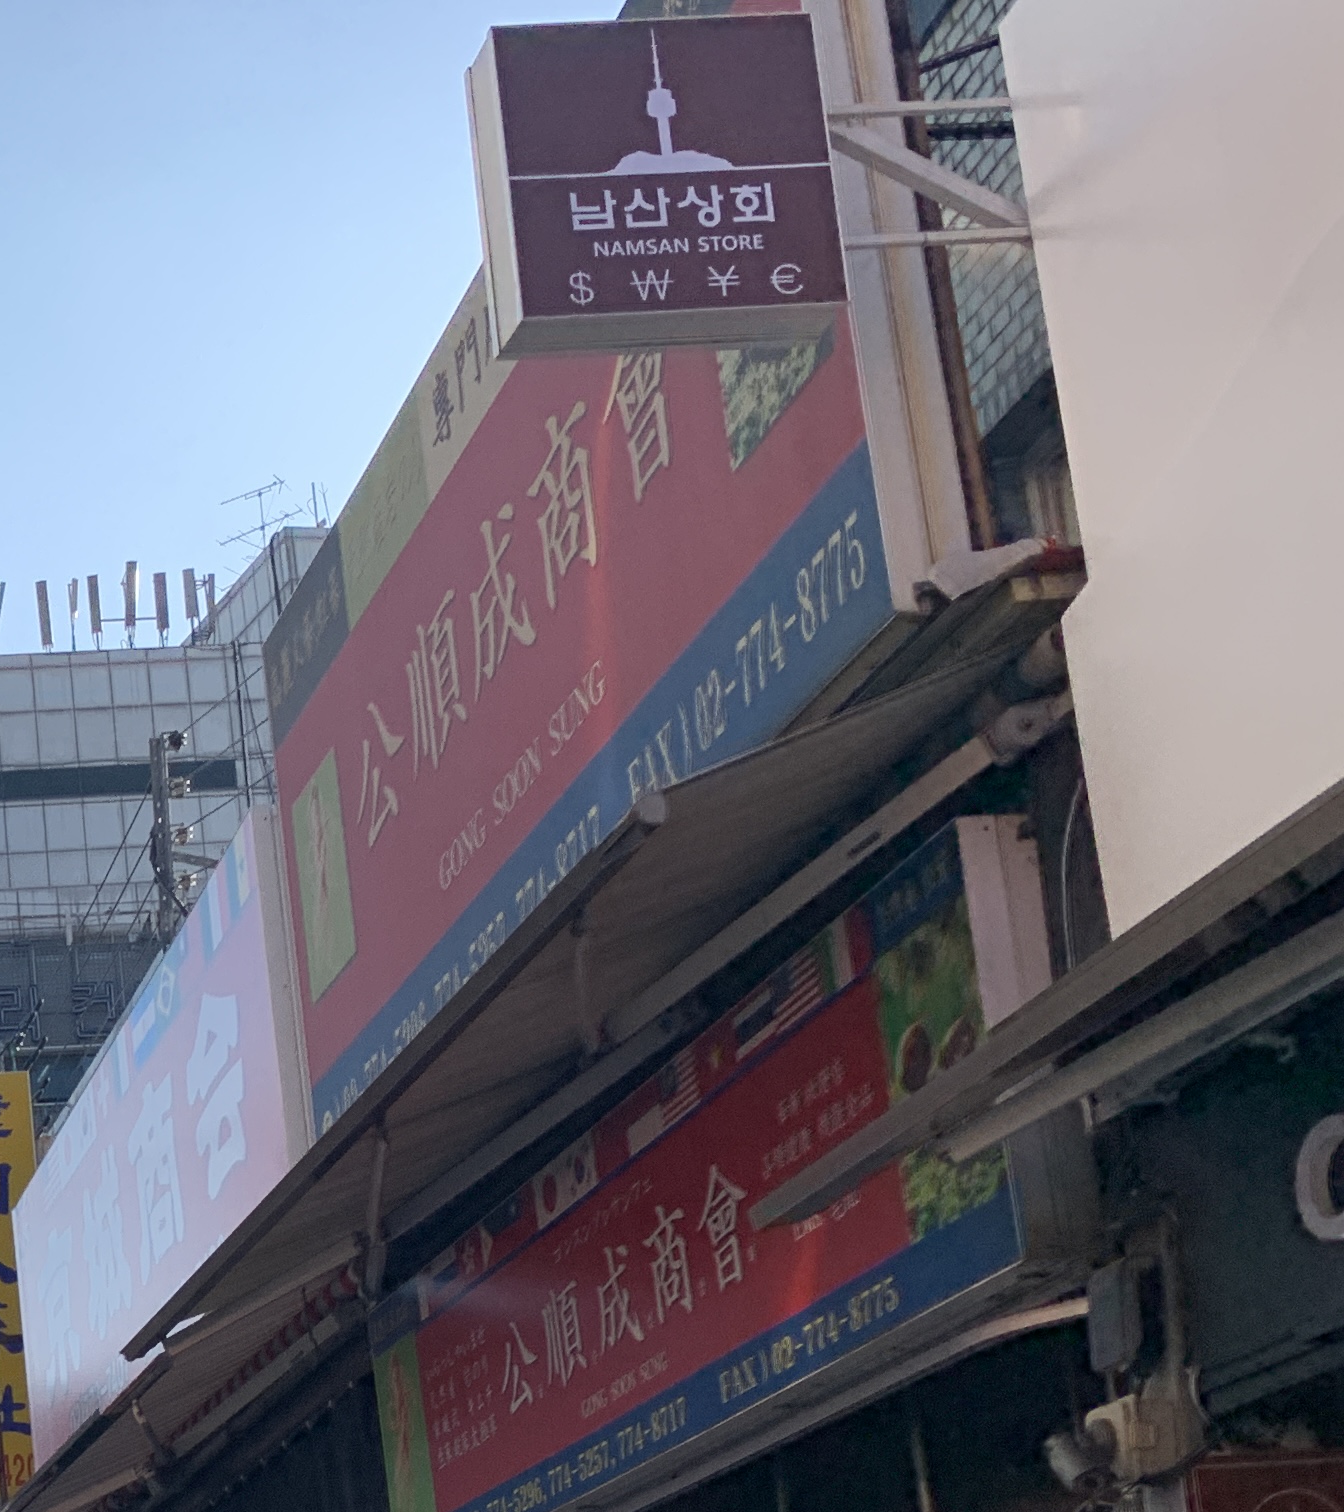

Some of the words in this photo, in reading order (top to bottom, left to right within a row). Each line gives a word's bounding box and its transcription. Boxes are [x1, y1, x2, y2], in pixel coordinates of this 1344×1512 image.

[569, 182, 776, 231] 남산상회
[592, 237, 690, 258] NAMSAN
[697, 233, 765, 254] STORE
